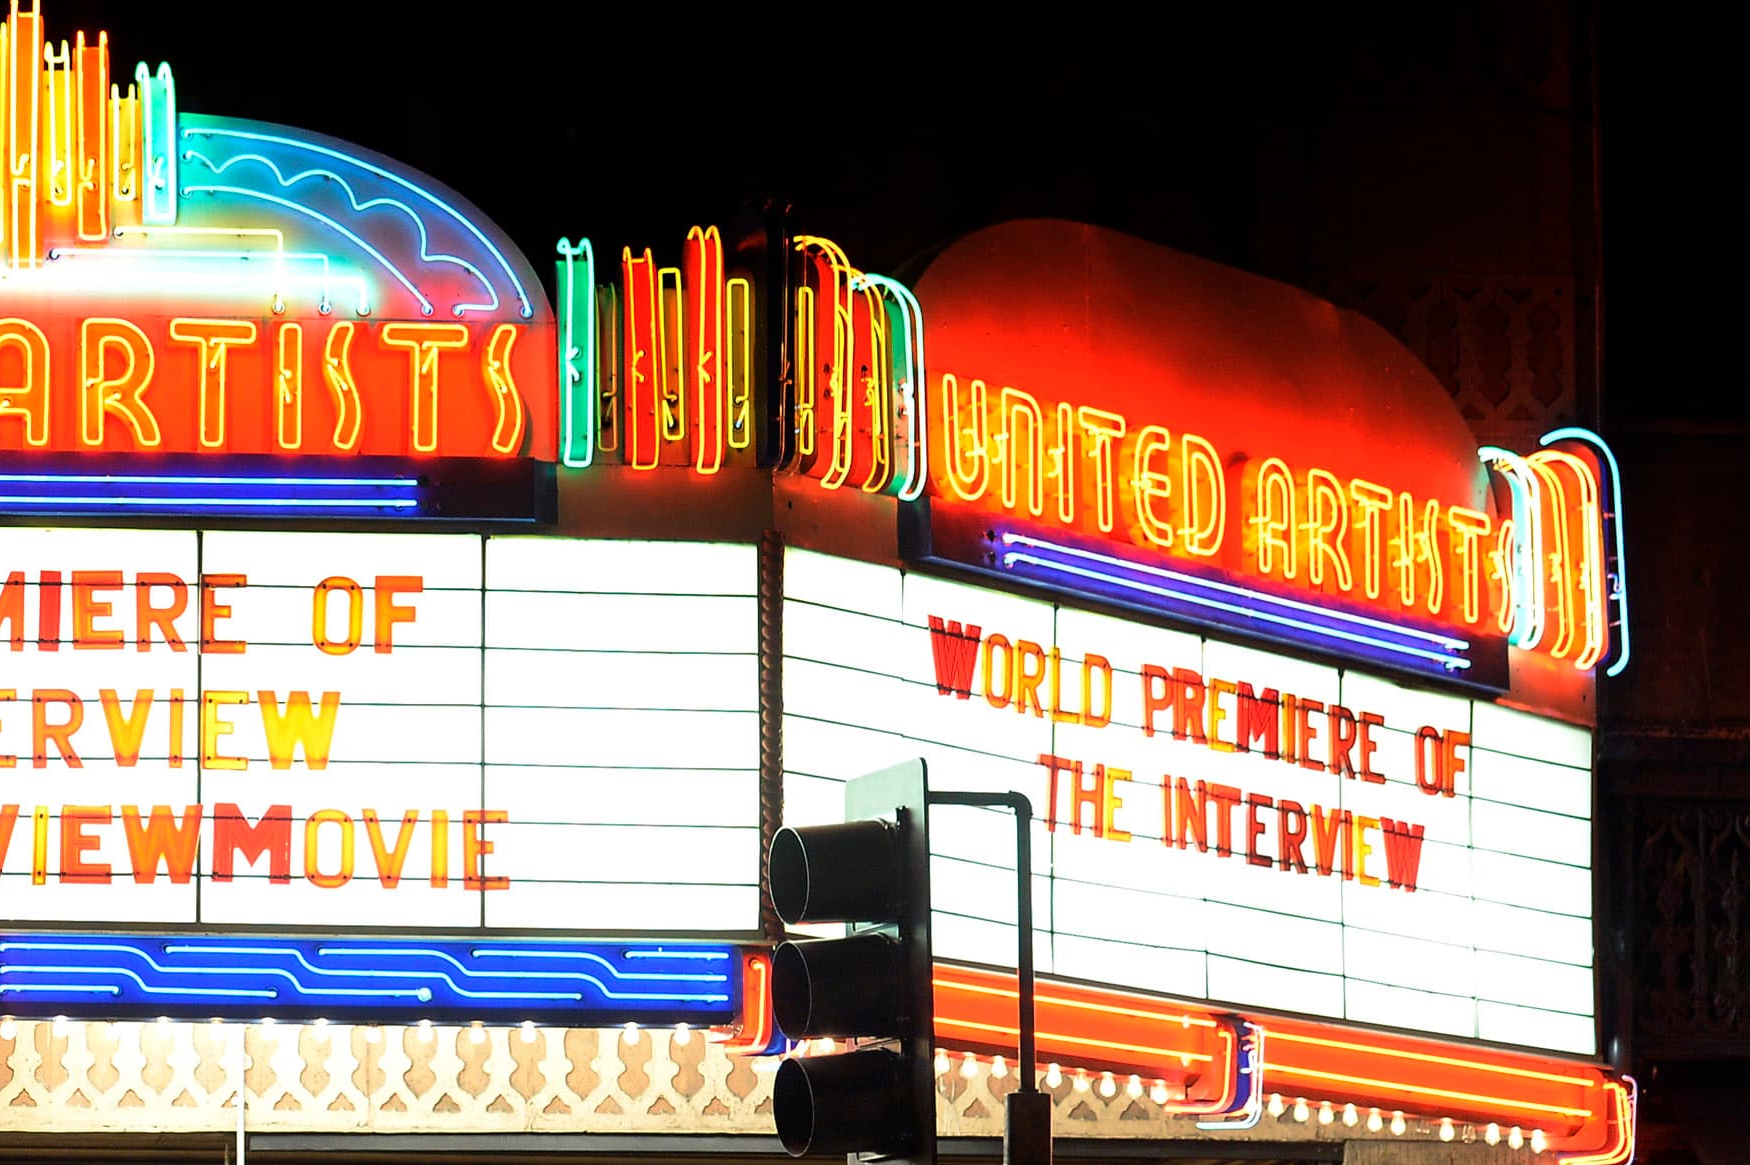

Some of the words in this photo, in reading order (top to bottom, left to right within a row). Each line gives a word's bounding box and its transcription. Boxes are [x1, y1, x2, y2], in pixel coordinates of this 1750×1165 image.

[938, 373, 1227, 558] UNITED
[1252, 456, 1517, 635] ARTISTS
[312, 575, 424, 655] OF
[927, 614, 1112, 729] WORLD
[1141, 662, 1386, 785] PREMIERE
[1415, 725, 1471, 798] OF
[1038, 753, 1132, 843] THE
[1161, 773, 1425, 893] INTERVIEW
